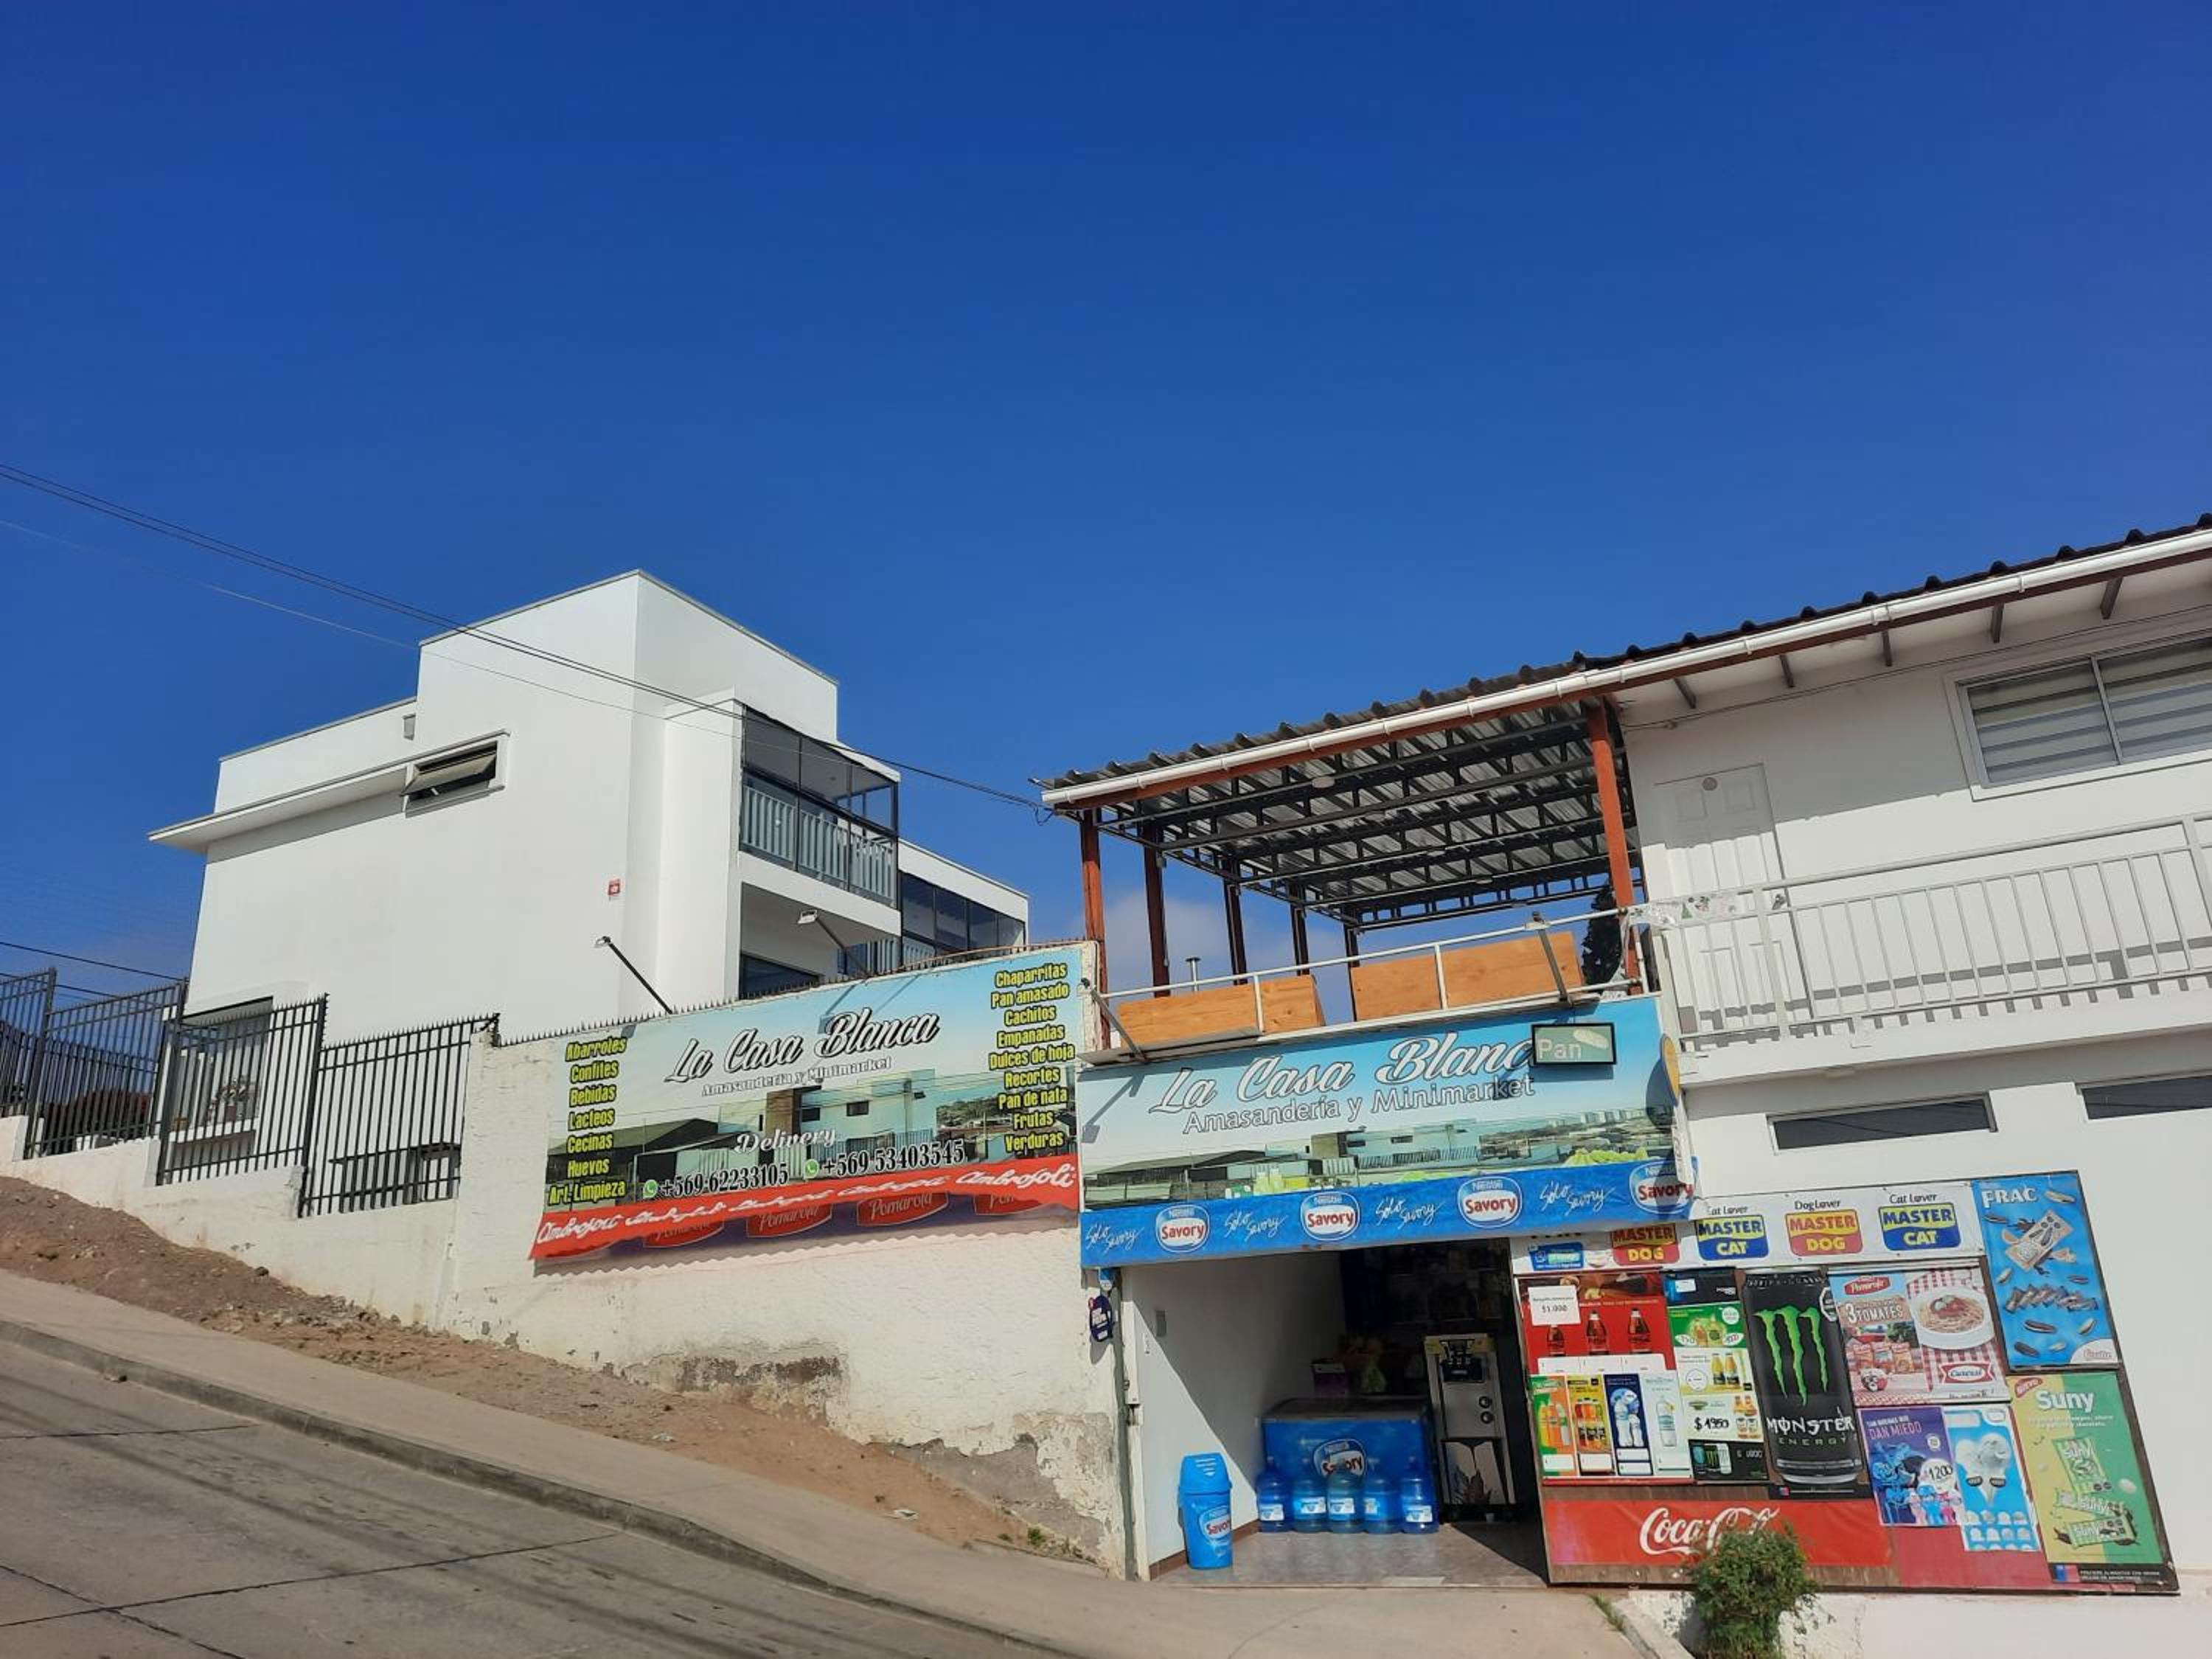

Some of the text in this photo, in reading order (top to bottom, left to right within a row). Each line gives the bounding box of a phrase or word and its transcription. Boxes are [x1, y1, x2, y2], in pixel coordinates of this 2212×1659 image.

[995, 963, 1068, 987] Chaparritas
[991, 981, 1070, 1009] Pan amasado
[1004, 1006, 1056, 1026] Cachitos
[664, 1007, 940, 1082] La Casa Blanca
[997, 1024, 1065, 1048] Empanadas
[565, 1037, 627, 1062] Abarrotes
[989, 1043, 1075, 1071] Dulces de hoja
[1538, 1039, 1582, 1060] Pan
[570, 1060, 619, 1084] Confites
[794, 1071, 805, 1087] y
[807, 1057, 891, 1081] Minimarket
[1004, 1066, 1060, 1090] Recortes
[1148, 1033, 1534, 1114] La Casa Blanc
[569, 1085, 616, 1107] Bebidas
[998, 1086, 1068, 1110] Pan de nata
[1183, 1074, 1535, 1135] Amasandería y Minimarket
[568, 1109, 615, 1131] Lacteos
[1013, 1110, 1054, 1130] Frutas
[567, 1133, 613, 1153] Cecinas
[732, 1127, 838, 1155] Delivery
[1004, 1132, 1064, 1152] Verduras
[568, 1158, 610, 1178] Huevos
[823, 1139, 966, 1177] +569 53403545
[708, 1162, 789, 1193] 62233105
[549, 1180, 626, 1206] Art. Limpieza
[1889, 1194, 1907, 1204] Cat
[1980, 1187, 2038, 1208] FRAC
[1465, 1198, 1516, 1214] Savory
[1883, 1207, 1953, 1225] MASTER
[1307, 1212, 1354, 1228] Savory
[1698, 1219, 1761, 1235] MASTER
[1790, 1217, 1856, 1232] MASTER
[1161, 1225, 1204, 1239] Savory
[1613, 1226, 1674, 1242] MASTER
[1902, 1230, 1938, 1245] CAT
[1628, 1248, 1664, 1261] DOG
[1716, 1240, 1747, 1256] CAT
[1806, 1237, 1846, 1251] DOG
[1846, 1303, 1903, 1324] 3 TOMATES
[2035, 1390, 2094, 1412] Suny
[1766, 1411, 1855, 1436] MONSTER
[1868, 1421, 1923, 1440] DAN MIEDO
[1778, 1437, 1846, 1446] ENERGY
